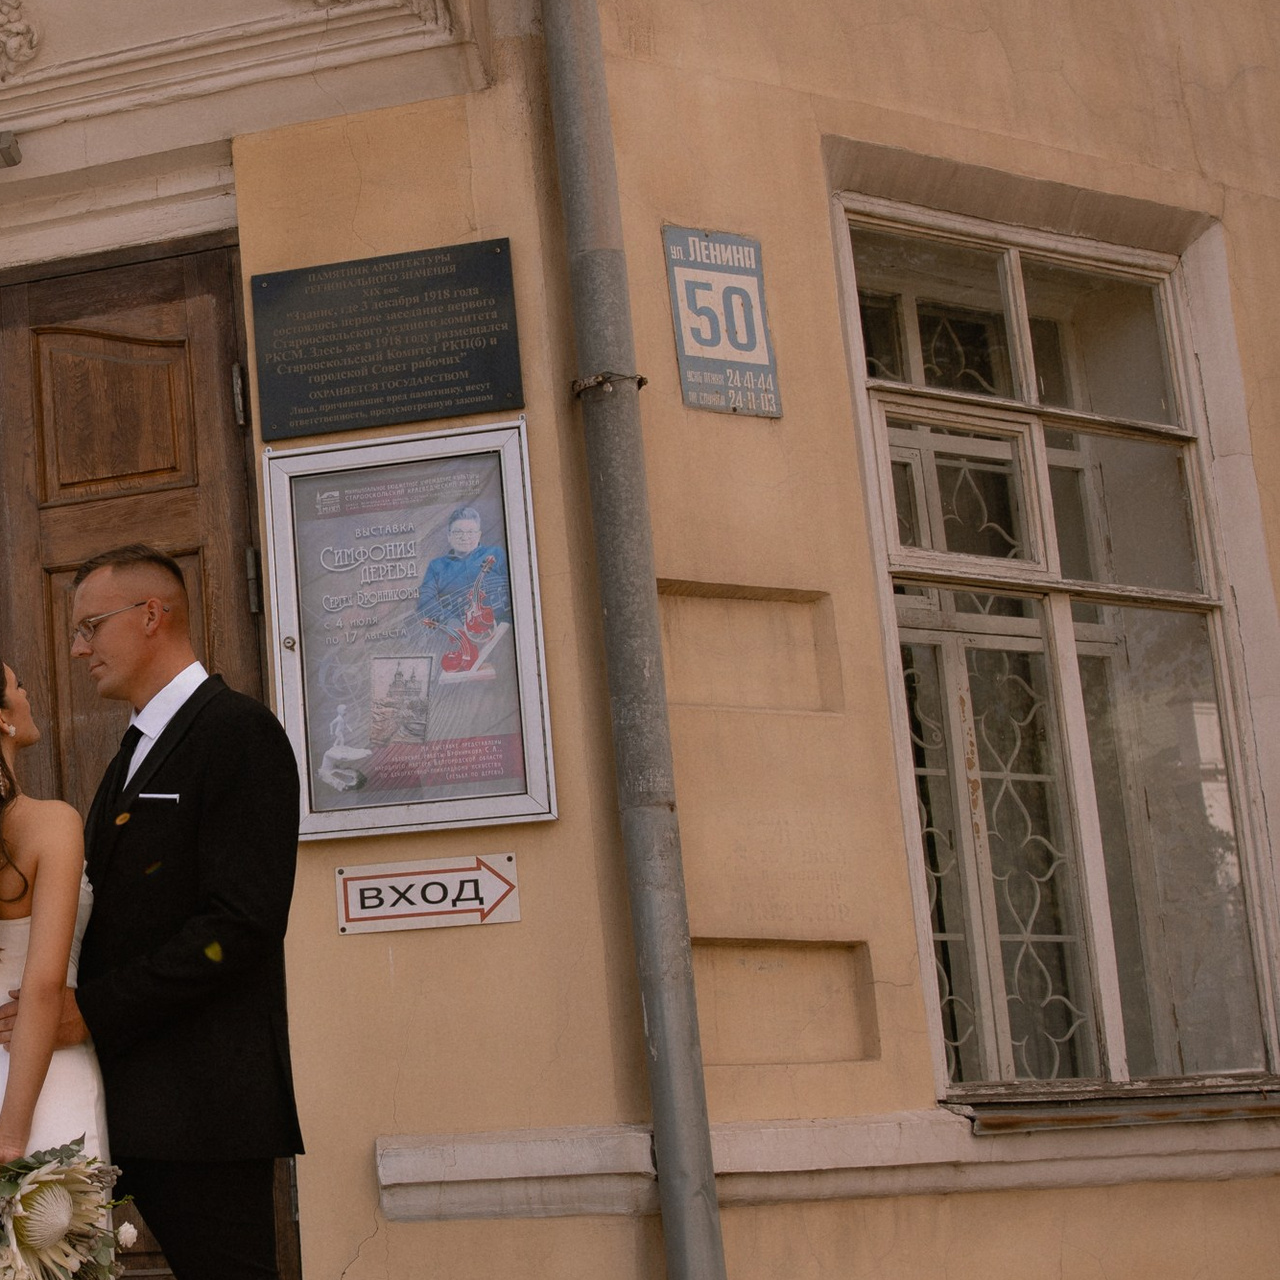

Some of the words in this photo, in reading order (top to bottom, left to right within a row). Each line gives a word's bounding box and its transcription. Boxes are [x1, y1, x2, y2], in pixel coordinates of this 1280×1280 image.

[687, 236, 756, 269] ЛЕНИНА
[305, 273, 398, 294] РЕГИОНАЛЬНОГО
[401, 264, 456, 280] ЗНАЧЕНИЯ
[308, 266, 369, 282] ПАМЯТНИК
[371, 254, 451, 273] АРХИТЕКТУРЫ
[343, 305, 359, 315] где
[361, 302, 368, 311] 3
[371, 295, 420, 312] декабря
[424, 290, 450, 302] 1918
[453, 287, 480, 299] года
[384, 286, 400, 295] век
[273, 320, 338, 338] состоялось
[342, 314, 383, 329] первое
[385, 305, 444, 322] заседание
[447, 297, 496, 314] первого
[273, 326, 382, 351] Старооскольского
[385, 319, 435, 336] уездного
[438, 310, 498, 327] комитета
[684, 279, 757, 353] 50
[265, 350, 306, 364] РКСМ.
[311, 345, 343, 359] Здесь
[346, 343, 361, 353] же
[365, 342, 371, 350] в
[375, 336, 401, 348] 1918
[405, 333, 430, 346] году
[434, 322, 509, 343] размещался
[276, 351, 384, 377] Старооскольский
[387, 344, 438, 360] Комитет
[442, 336, 487, 354] РКП(б)
[489, 337, 498, 346] и
[308, 366, 369, 386] городской
[371, 361, 407, 375] Совет
[309, 382, 379, 400] ОХРАНЯЕТСЯ
[381, 370, 470, 391] ГОСУДАРСТВОМ
[289, 410, 368, 429] ответственность,
[369, 398, 453, 419] предусмотренную
[454, 393, 494, 406] законом
[319, 396, 384, 413] причинившие
[386, 393, 408, 404] вред
[410, 385, 462, 401] памятнику,
[465, 382, 491, 394] несут
[345, 489, 405, 502] СТАРООСКОЛЬСКИЙ
[408, 482, 457, 494] КРАЕВЕДЧЕСКИЙ
[459, 479, 480, 487] МУЗЕЙ
[355, 522, 415, 538] ВЫСТАВКА
[360, 561, 418, 585] ДЕРЕВА
[335, 617, 344, 628] 4
[344, 630, 358, 643] 17
[359, 878, 484, 910] ВХОД
